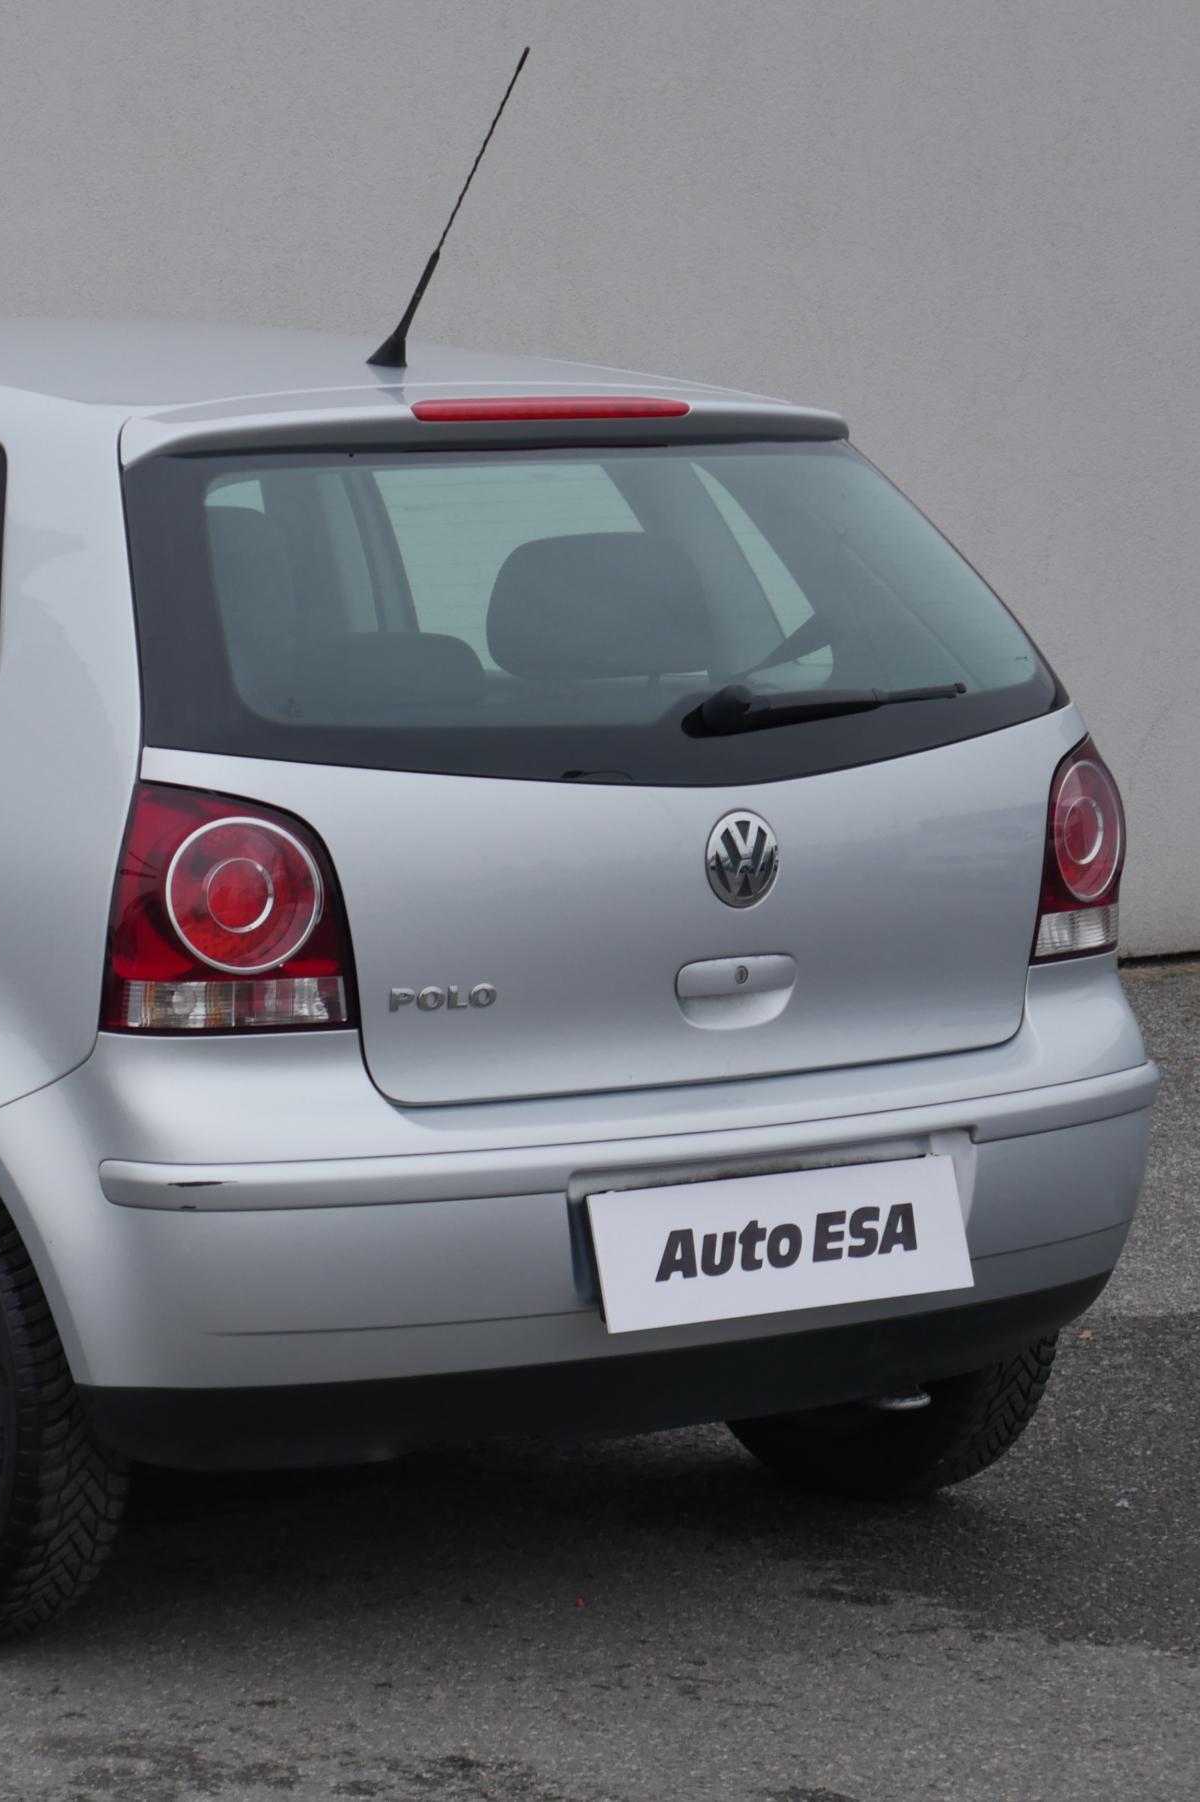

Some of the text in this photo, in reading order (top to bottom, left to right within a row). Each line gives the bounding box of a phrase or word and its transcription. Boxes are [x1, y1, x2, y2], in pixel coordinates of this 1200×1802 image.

[388, 982, 498, 1013] POLO
[654, 1202, 919, 1283] Auto ESA
